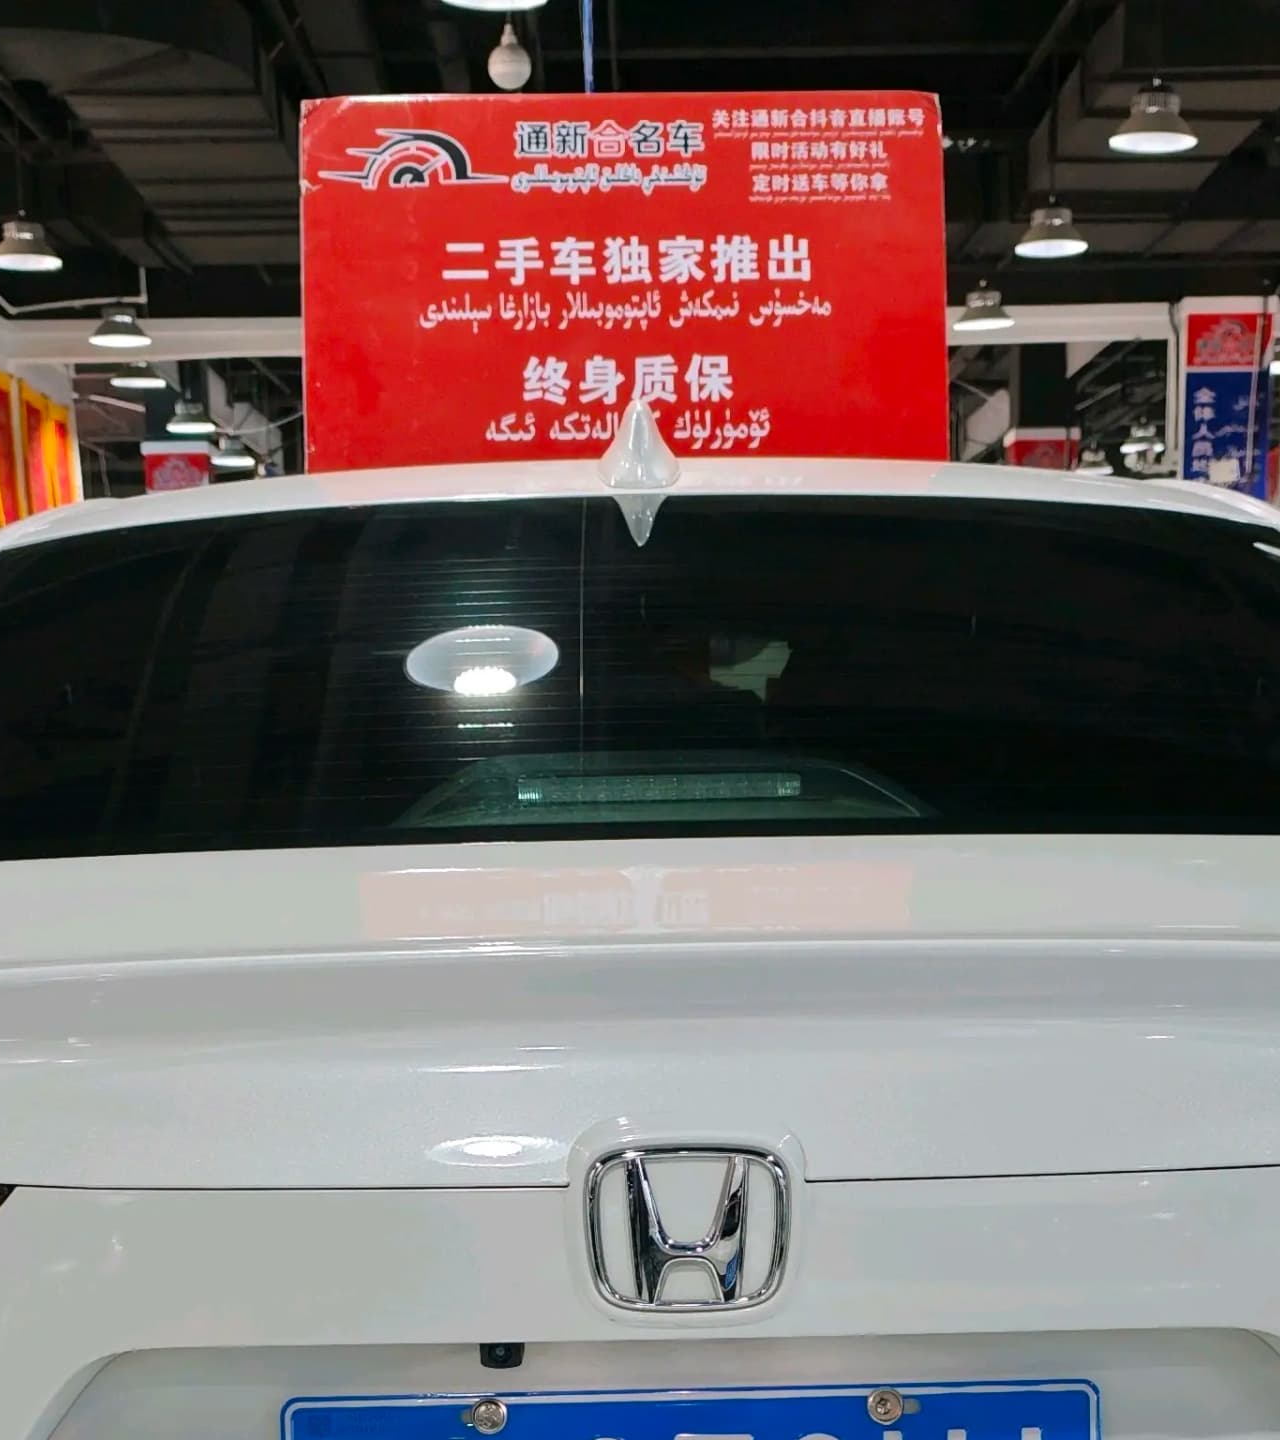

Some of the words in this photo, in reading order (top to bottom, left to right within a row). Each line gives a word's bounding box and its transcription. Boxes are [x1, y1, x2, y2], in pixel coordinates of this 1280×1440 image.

[513, 120, 705, 159] 通新合名车
[750, 140, 888, 161] 限时活动有好礼
[750, 172, 889, 193] 定时送车等你拿
[441, 233, 813, 285] 二手车独家推出
[522, 354, 734, 404] 终身质保
